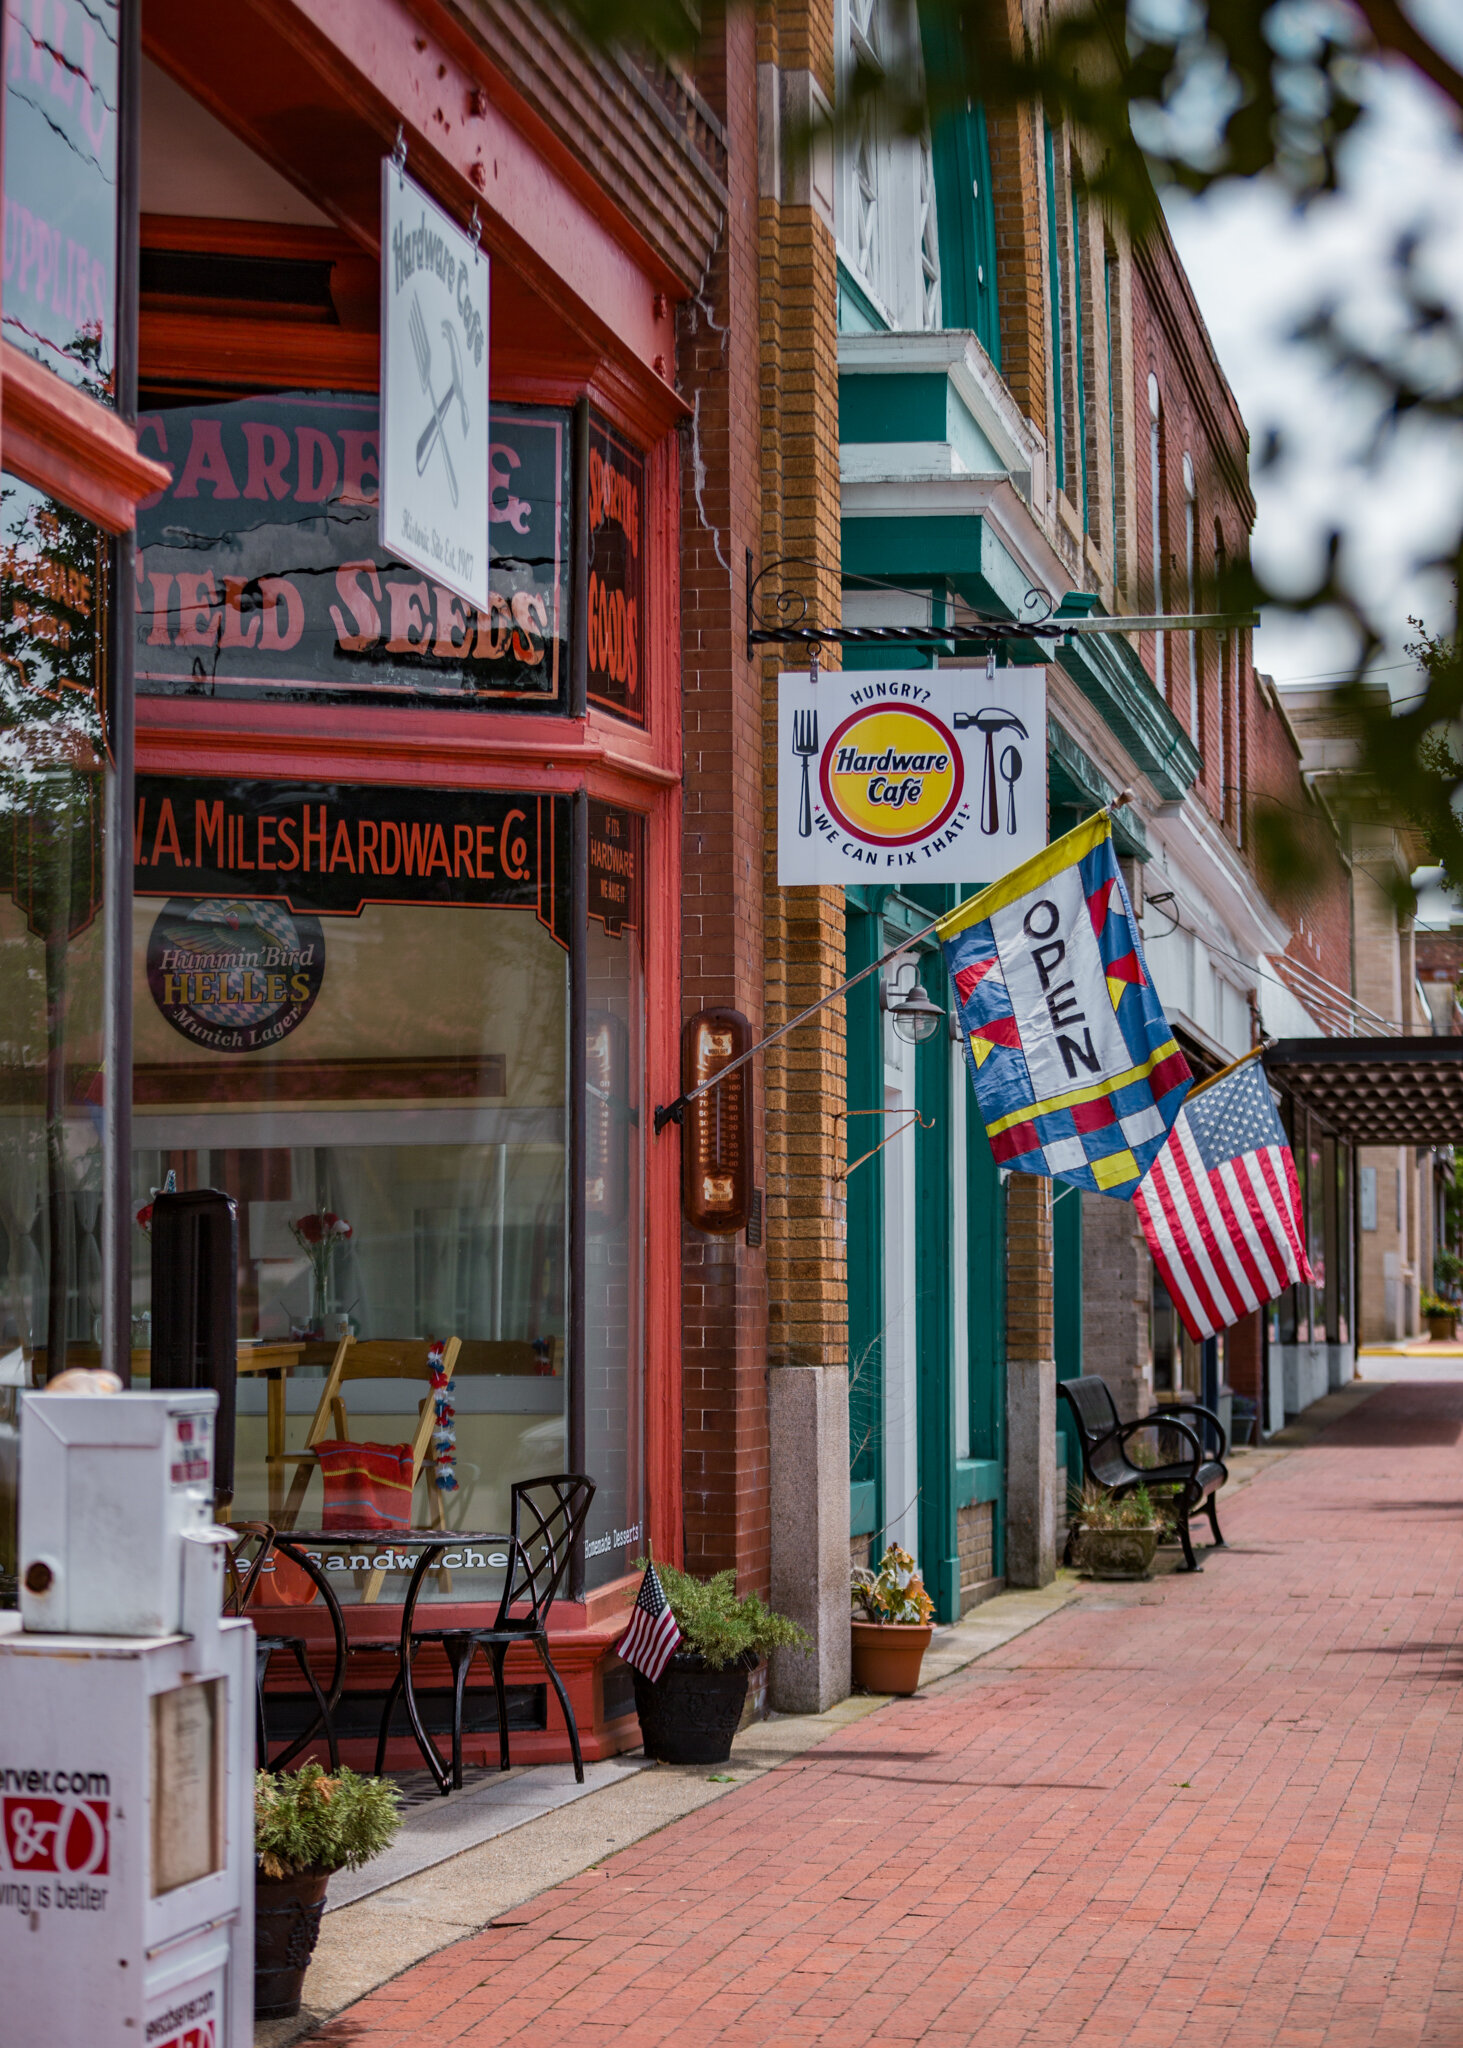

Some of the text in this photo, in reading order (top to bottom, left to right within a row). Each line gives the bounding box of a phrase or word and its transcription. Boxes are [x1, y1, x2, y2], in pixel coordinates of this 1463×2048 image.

[3, 197, 107, 334] UPPLIES
[392, 210, 484, 368] Hardware Café
[136, 547, 305, 652] IELD
[588, 570, 638, 694] GOODS
[850, 681, 931, 705] HUNGRY?
[835, 746, 950, 774] Hardware
[867, 776, 923, 809] Café
[303, 804, 495, 879] HARDWARE
[590, 839, 634, 879] HARDWARE
[814, 811, 972, 867] WE CAN FIX THAT!
[163, 972, 311, 1005] HELLES
[1023, 899, 1102, 1079] OPEN
[174, 1006, 301, 1047] Munich Lager
[585, 1531, 612, 1560] Homemade
[613, 1523, 639, 1548] Desserts
[0, 1767, 110, 1797] rver.com
[55, 1879, 109, 1912] better
